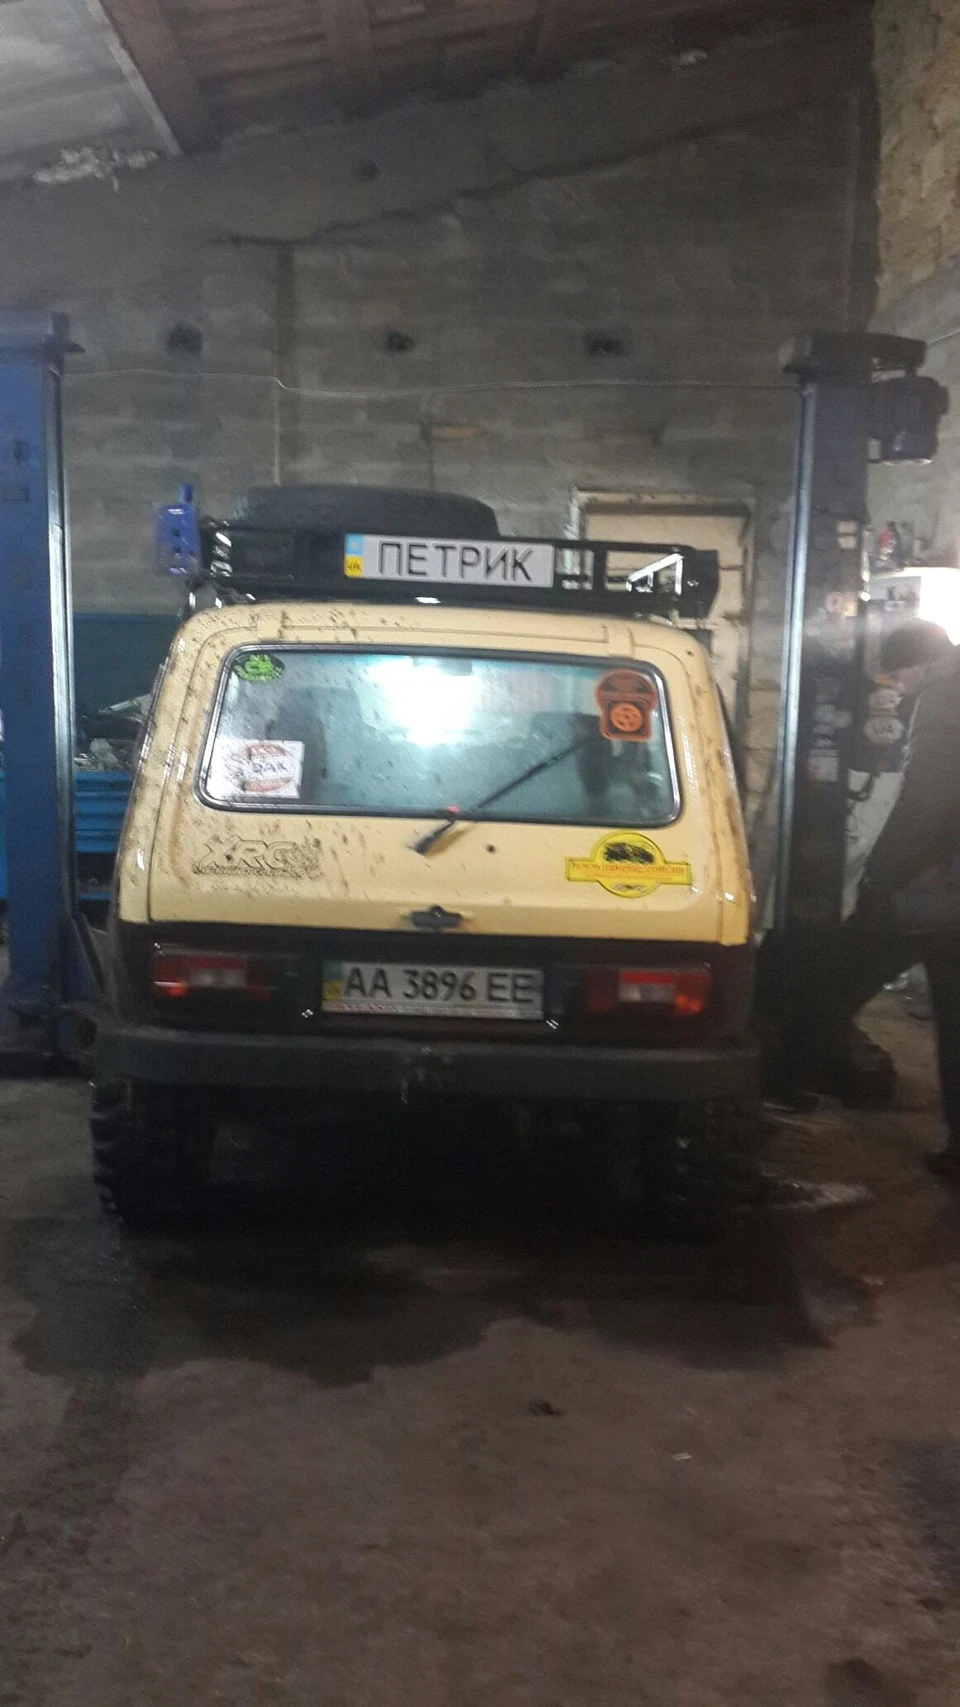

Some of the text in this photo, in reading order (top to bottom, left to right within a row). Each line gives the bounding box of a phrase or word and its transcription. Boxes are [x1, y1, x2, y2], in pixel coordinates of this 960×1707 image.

[378, 540, 533, 582] ПЕТРИК
[344, 966, 536, 1003] AA 3896 EE
